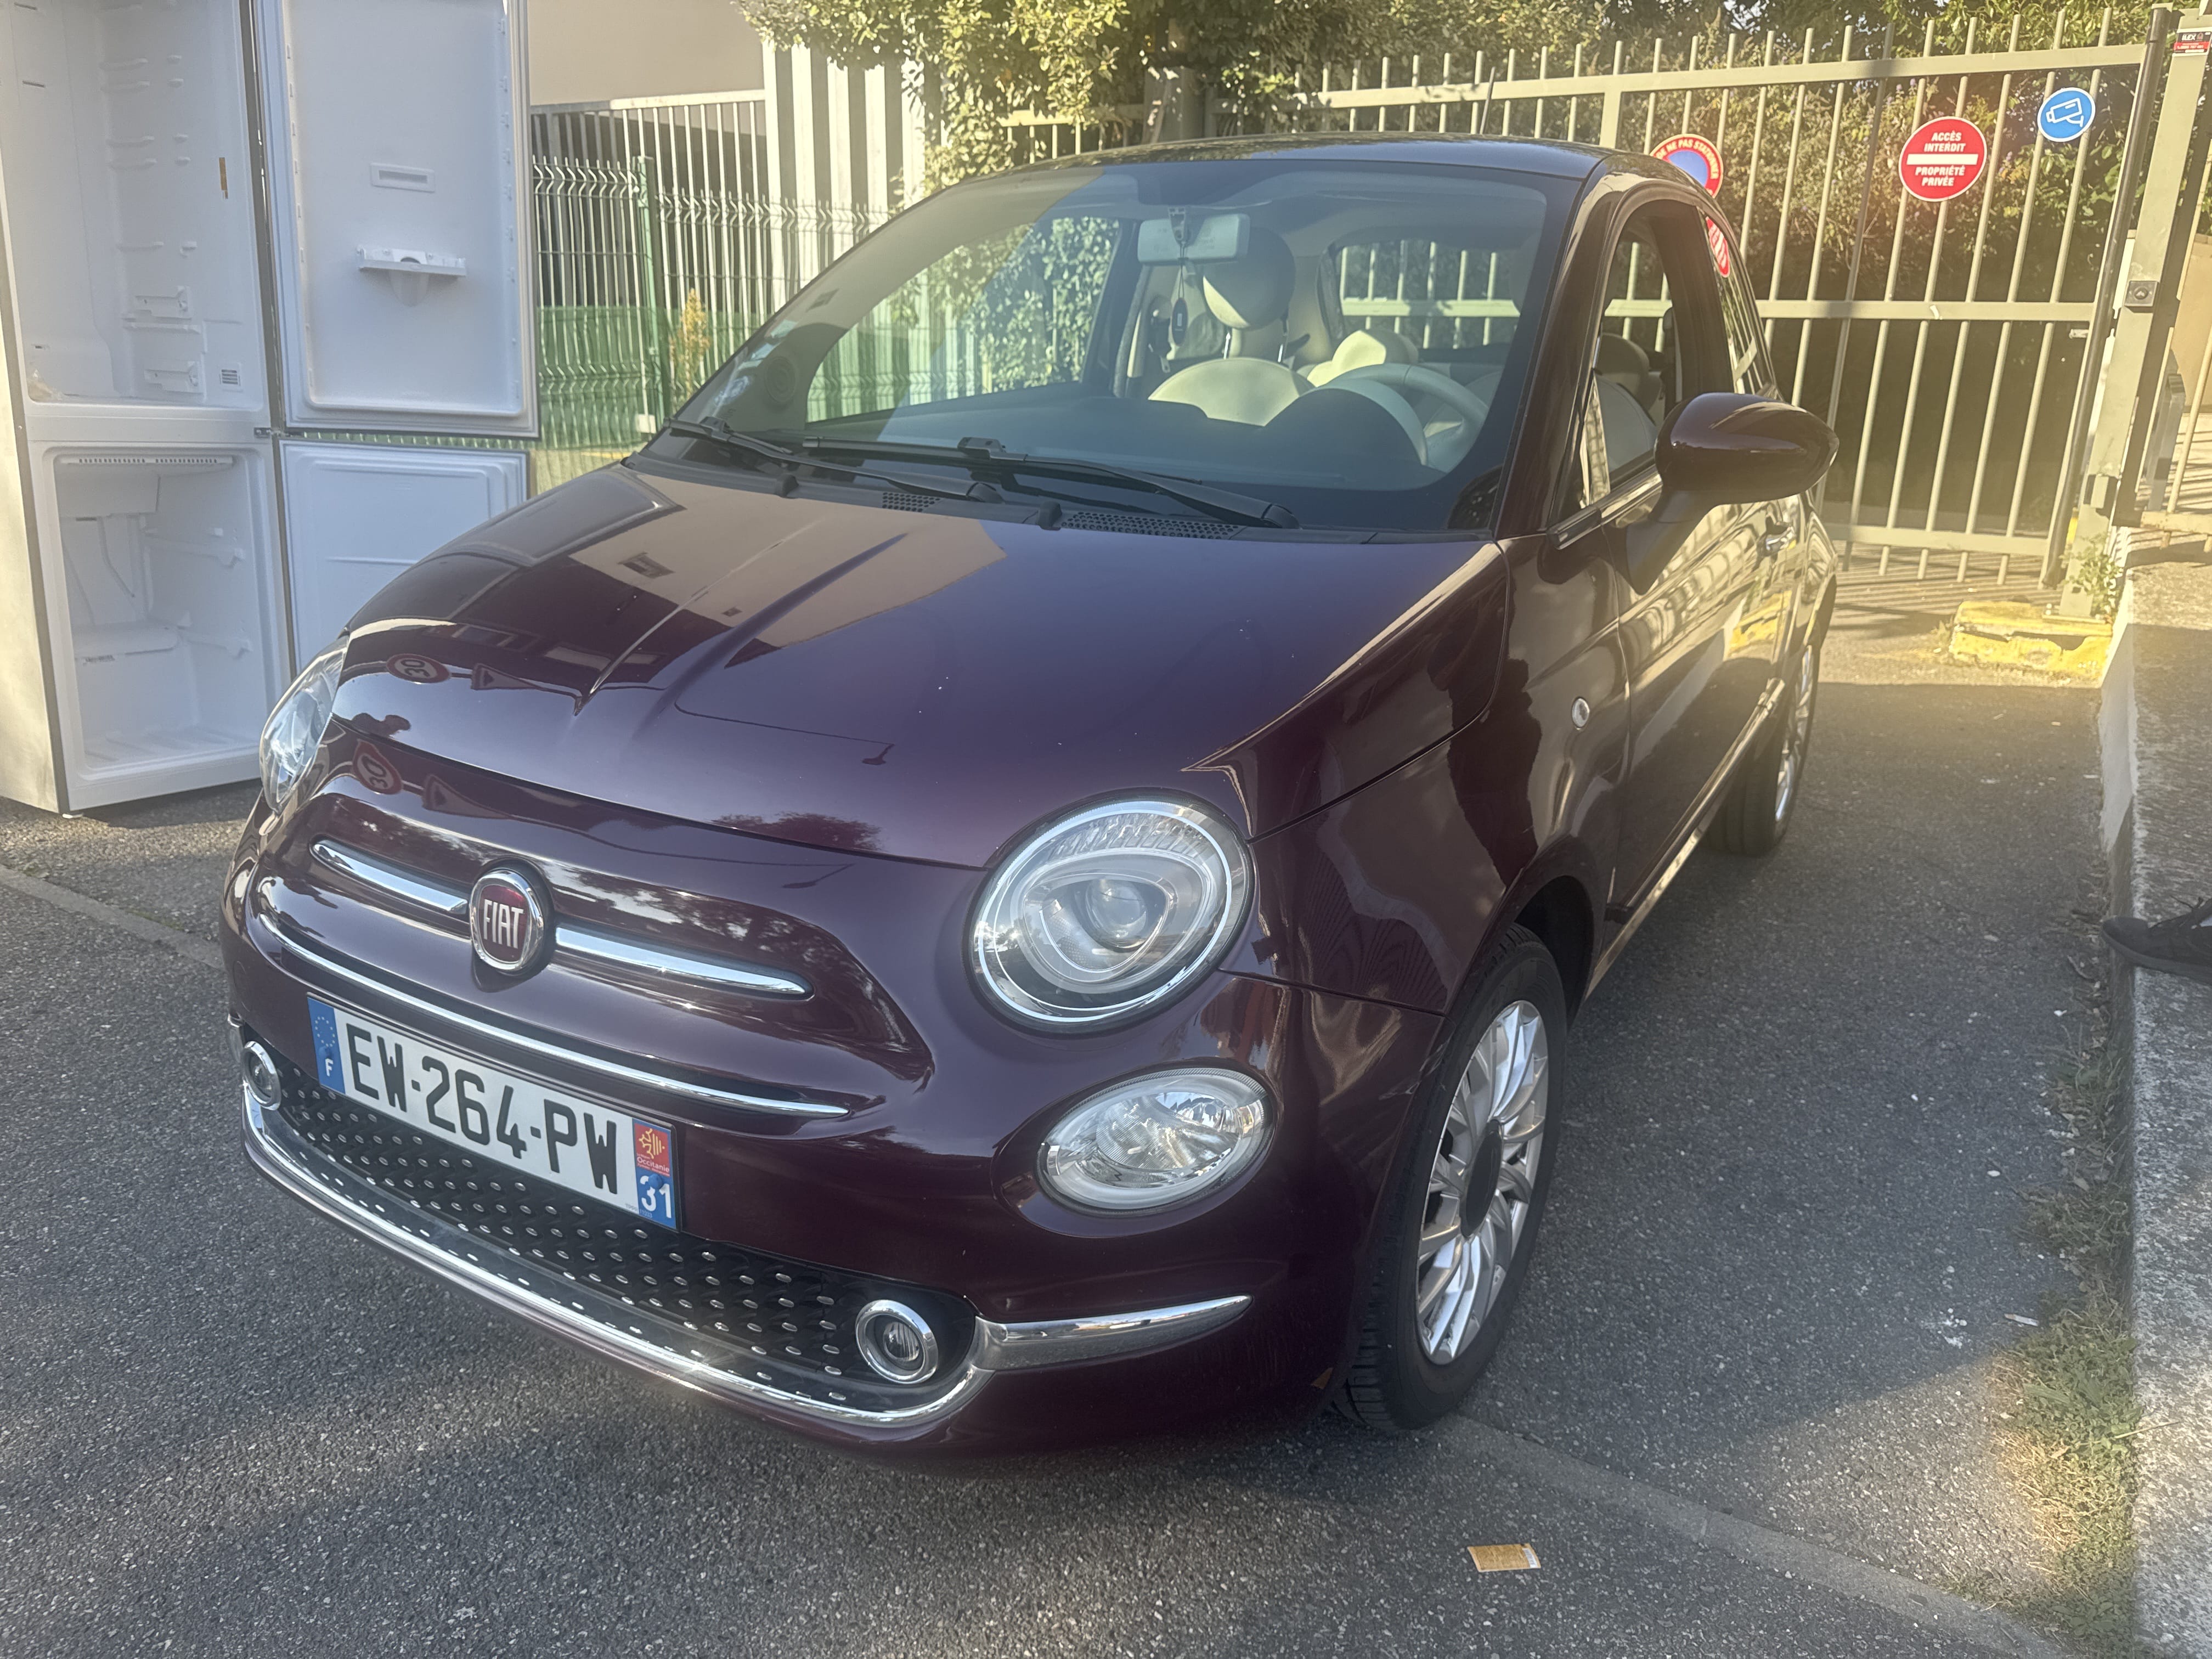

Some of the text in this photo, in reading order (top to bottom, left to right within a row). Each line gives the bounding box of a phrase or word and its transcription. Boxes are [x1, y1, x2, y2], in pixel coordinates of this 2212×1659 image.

[1931, 130, 1962, 142] ACCÈS
[1666, 141, 1678, 152] NE
[1678, 138, 1694, 149] PAS
[1923, 143, 1966, 153] INTERDIT
[1915, 165, 1966, 176] PROPRIÉTÉ
[1921, 175, 1955, 187] PRIVÉE
[483, 899, 524, 949] FIAT
[325, 1058, 334, 1076] F
[346, 1023, 618, 1194] EW-264-PW
[637, 1156, 670, 1173] Occitanie
[640, 1175, 672, 1219] 31
